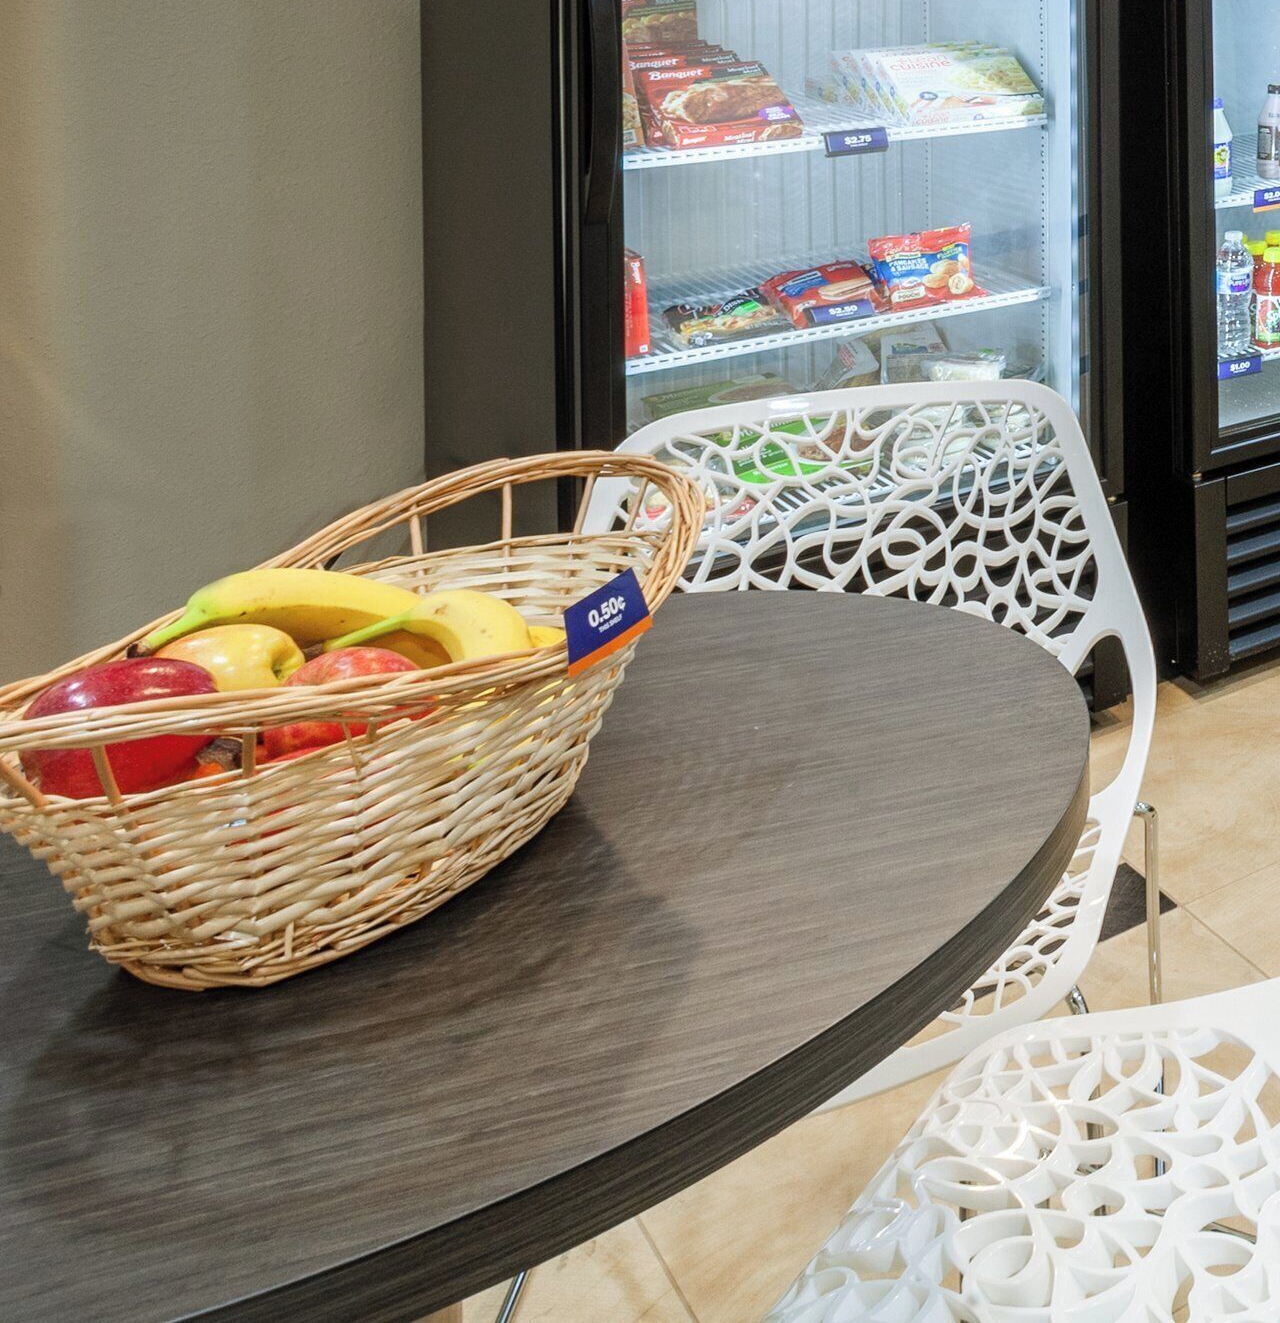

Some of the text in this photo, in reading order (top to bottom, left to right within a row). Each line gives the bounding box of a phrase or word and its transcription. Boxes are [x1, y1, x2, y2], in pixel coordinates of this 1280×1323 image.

[649, 67, 704, 81] Banquet
[844, 134, 872, 145] $2.75
[829, 304, 858, 316] $2.50
[1230, 361, 1250, 371] $1.00
[588, 596, 626, 627] 0.50¢
